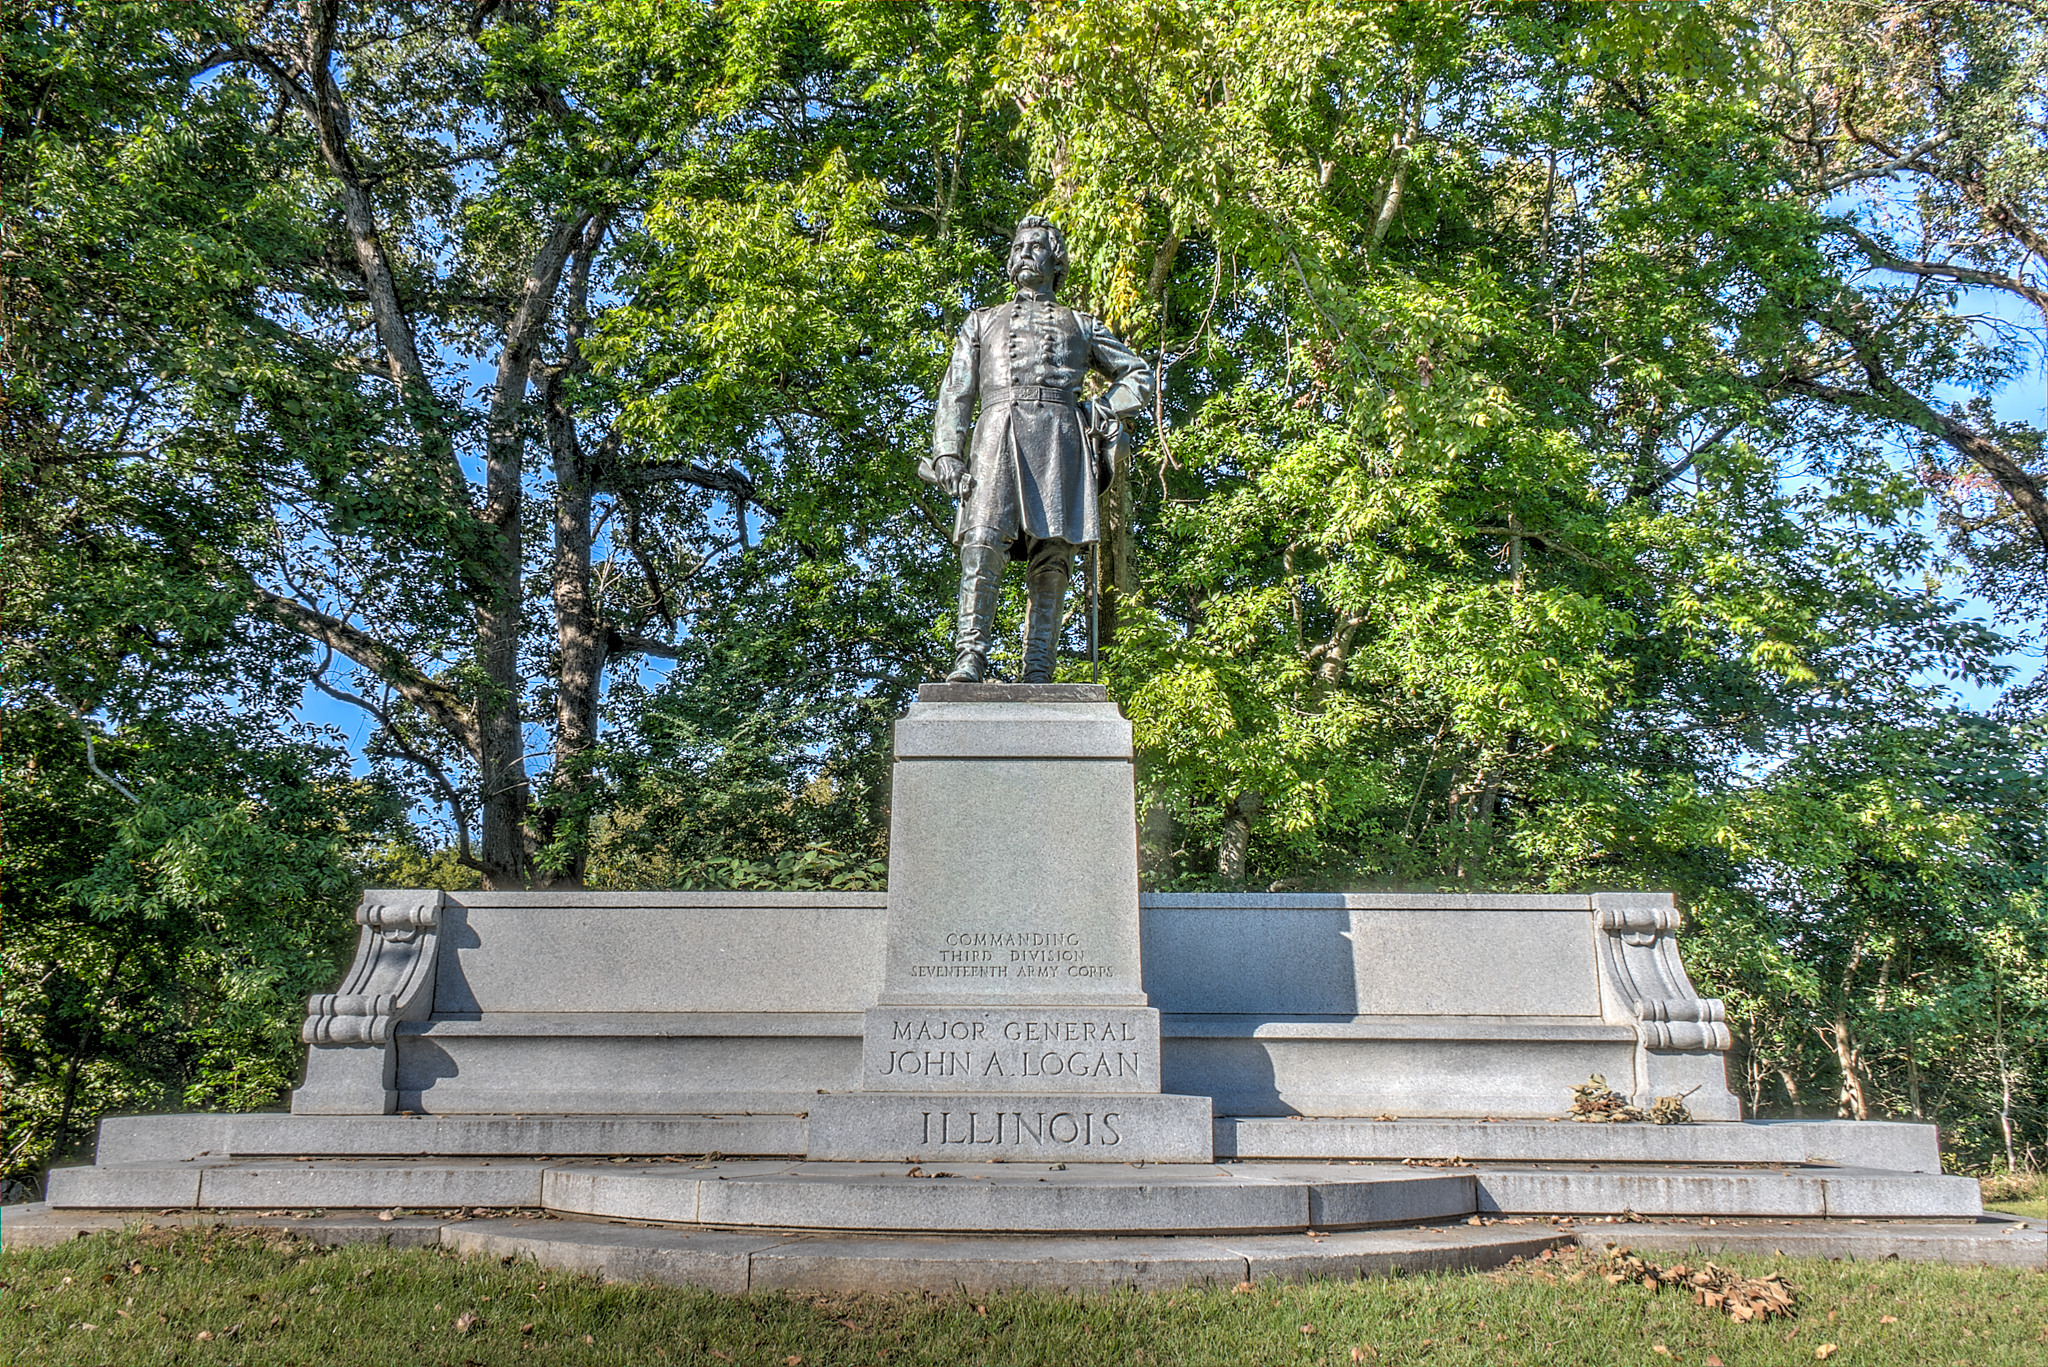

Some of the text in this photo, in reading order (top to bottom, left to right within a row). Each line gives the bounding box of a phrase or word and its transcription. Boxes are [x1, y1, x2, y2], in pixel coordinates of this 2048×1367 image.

[946, 933, 1079, 946] COMMANDING
[939, 950, 1084, 962] THIRD DIVISION
[911, 965, 1113, 978] SEVENTEENTH ARMY CORPS
[892, 1020, 1136, 1041] MAJOR GENERAL
[879, 1051, 971, 1076] JOHN
[1022, 1051, 1140, 1077] LOGAN
[921, 1112, 1121, 1146] ILLINOIS
